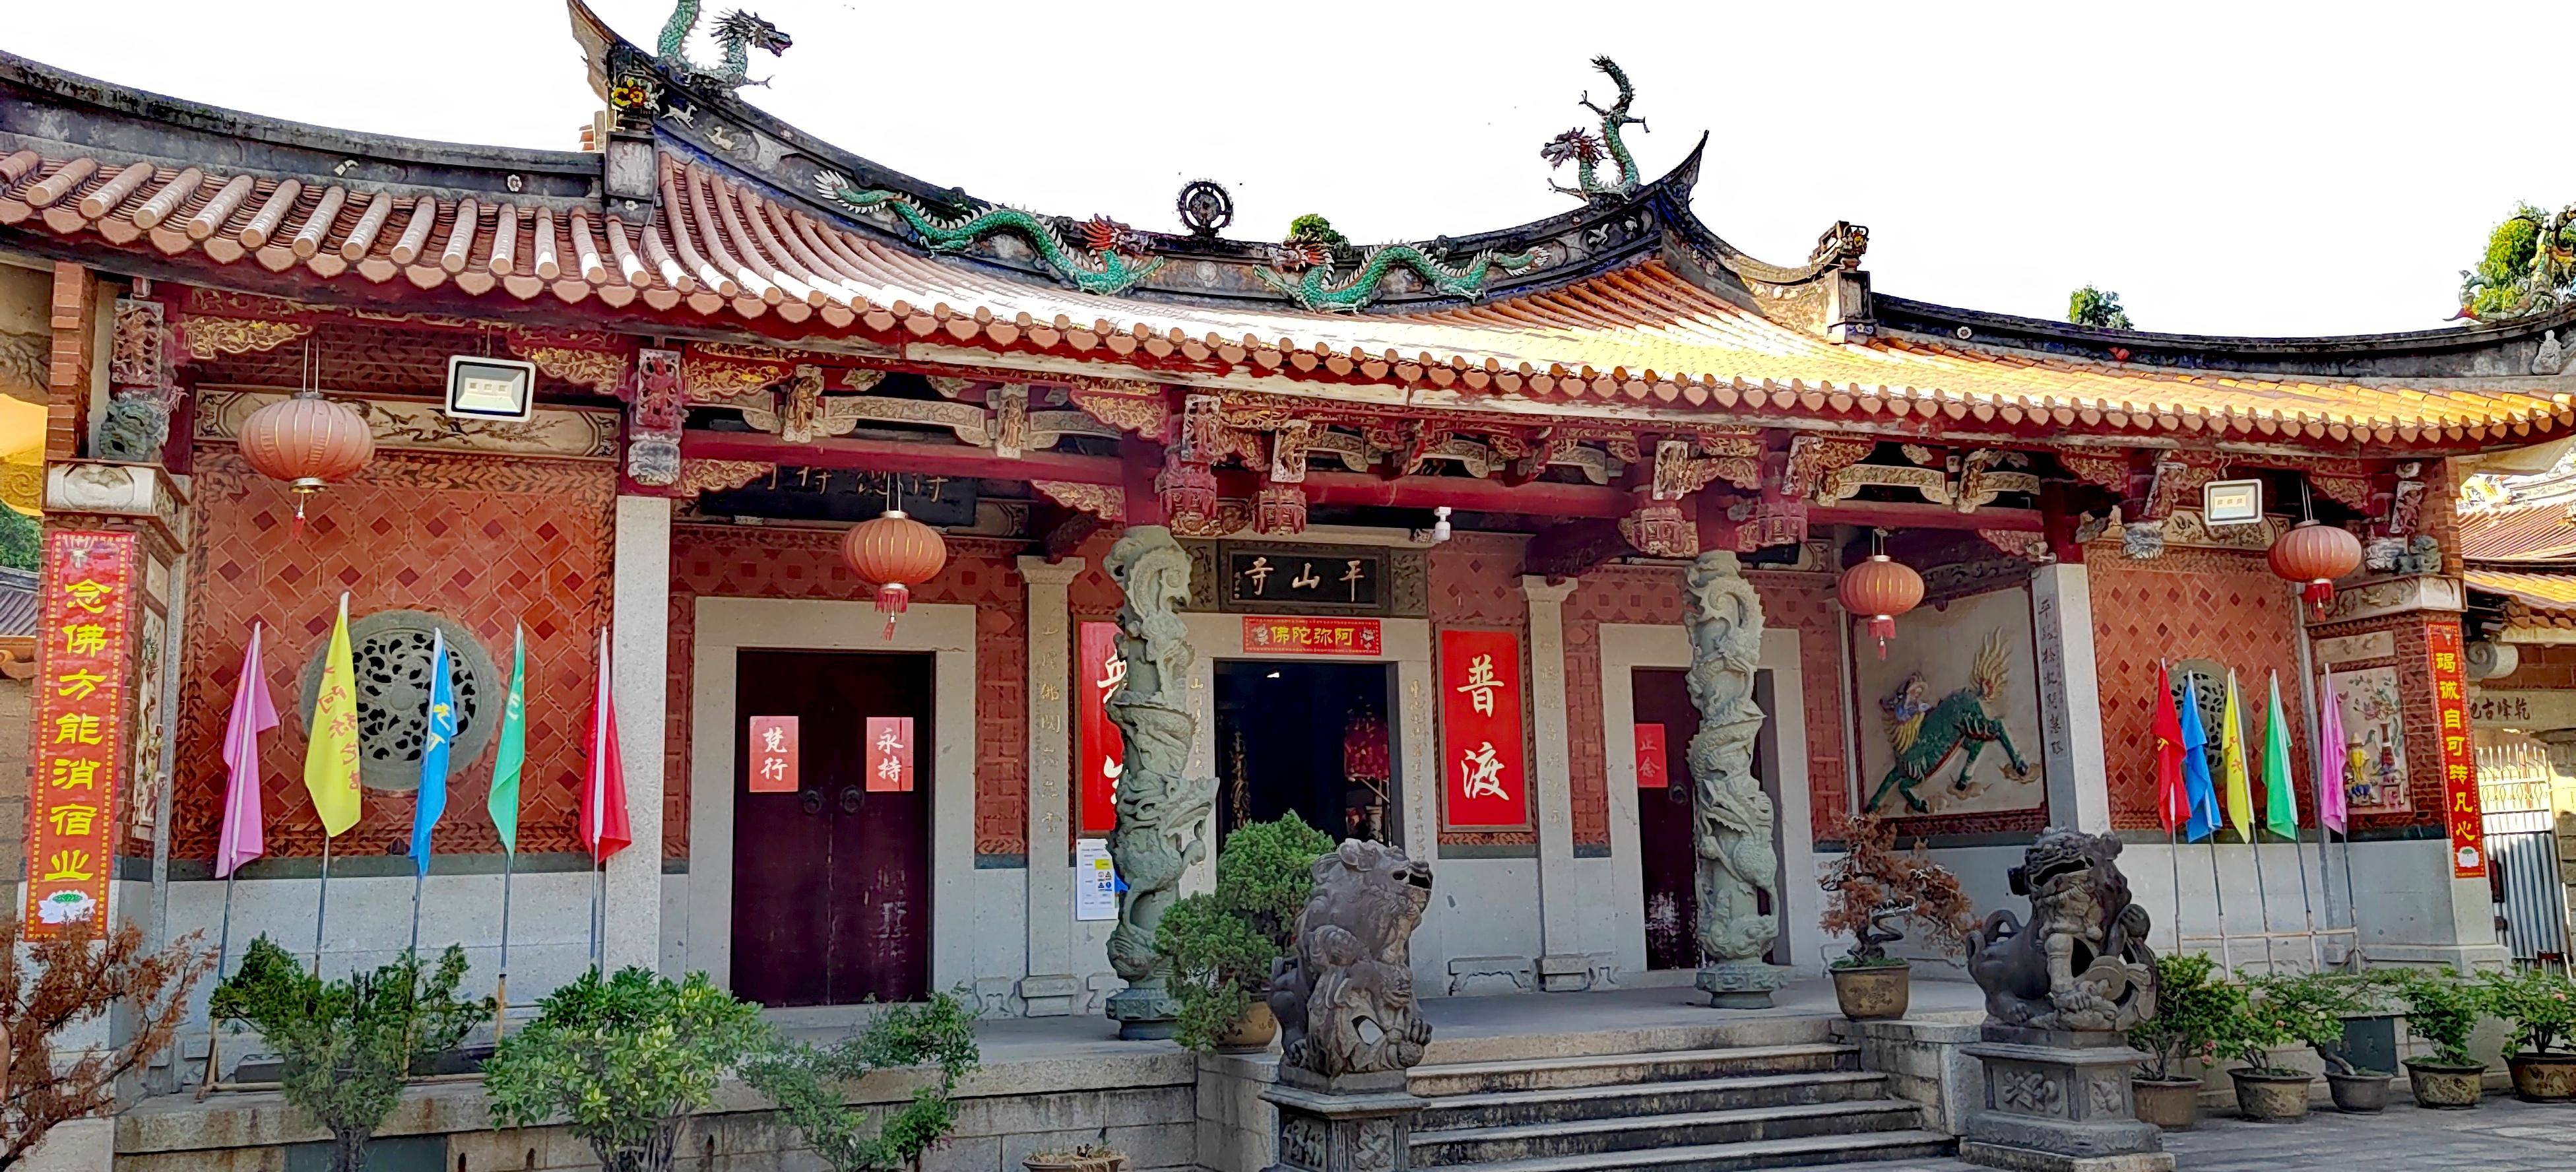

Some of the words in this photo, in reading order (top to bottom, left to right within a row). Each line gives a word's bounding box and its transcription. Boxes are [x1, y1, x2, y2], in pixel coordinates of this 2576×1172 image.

[44, 578, 112, 882] 念佛方能消宿业
[760, 727, 789, 781] 梵行
[1456, 653, 1510, 800] 普渡
[1639, 733, 1661, 777] 正念
[876, 727, 904, 784] 永持
